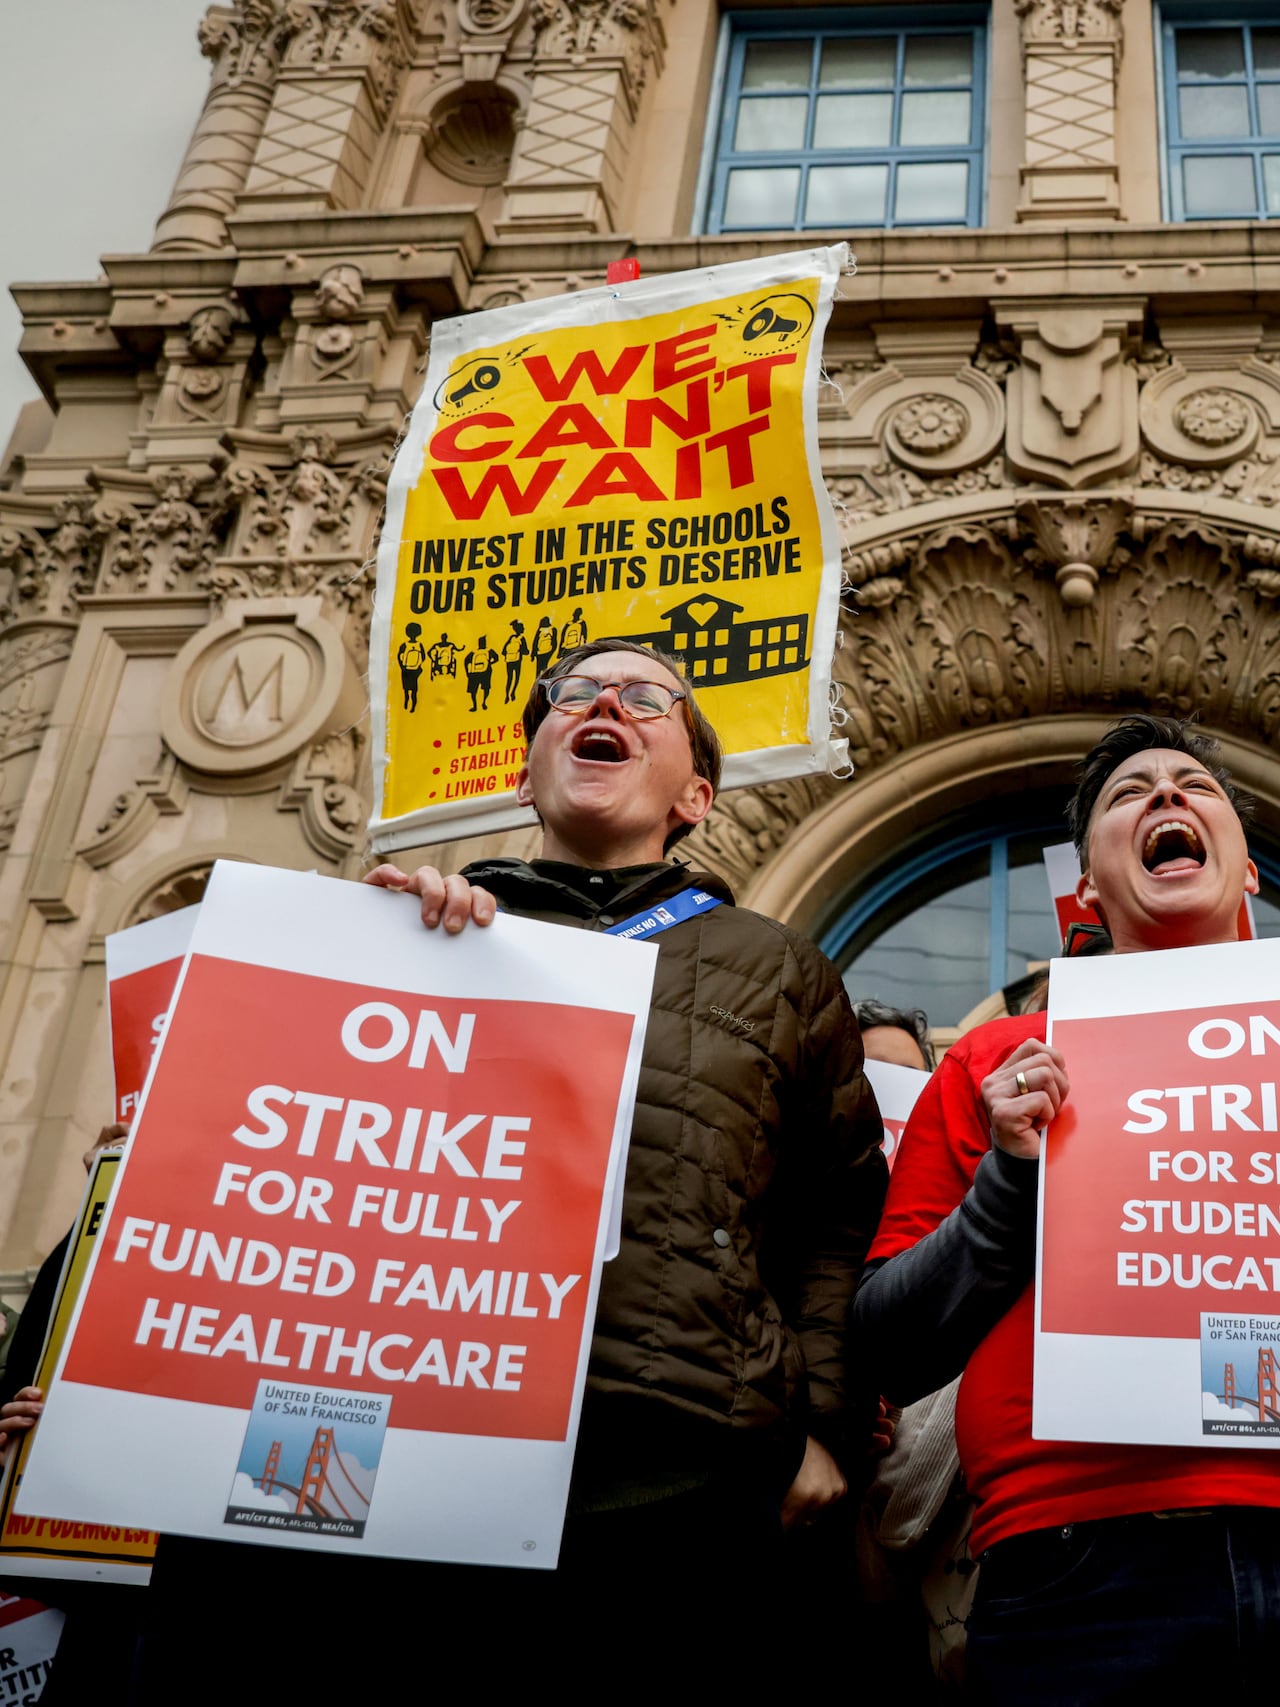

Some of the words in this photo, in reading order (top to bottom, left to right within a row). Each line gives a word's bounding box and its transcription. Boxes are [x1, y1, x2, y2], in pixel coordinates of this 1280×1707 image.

[522, 324, 717, 402] WE
[429, 353, 797, 463] CAN'T
[431, 416, 770, 520] WAIT
[412, 531, 524, 574] INVEST
[535, 526, 566, 563] IN
[577, 519, 635, 555] THE
[646, 496, 791, 549] SCHOOLS
[409, 576, 475, 615] OUR
[486, 554, 647, 607] STUDENTS
[658, 536, 802, 585] DESERVE
[450, 747, 527, 774] STABILITY
[458, 724, 506, 749] FULLY
[445, 775, 497, 799] LIVING
[341, 1001, 477, 1073] ON
[231, 1084, 531, 1181] STRIKE
[1148, 1150, 1238, 1183] FOR
[212, 1162, 334, 1224] FOR
[348, 1184, 522, 1244] FULLY
[113, 1216, 356, 1297] FUNDED
[368, 1259, 582, 1320] FAMILY
[134, 1297, 528, 1392] HEALTHCARE
[1207, 1317, 1246, 1329] UNITED
[1210, 1330, 1223, 1340] OF
[1225, 1329, 1247, 1341] SAN
[264, 1385, 311, 1403] UNITED
[313, 1391, 383, 1412] EDUCATORS
[264, 1402, 280, 1413] OF
[281, 1402, 308, 1417] SAN
[310, 1405, 377, 1425] FRANCISCO
